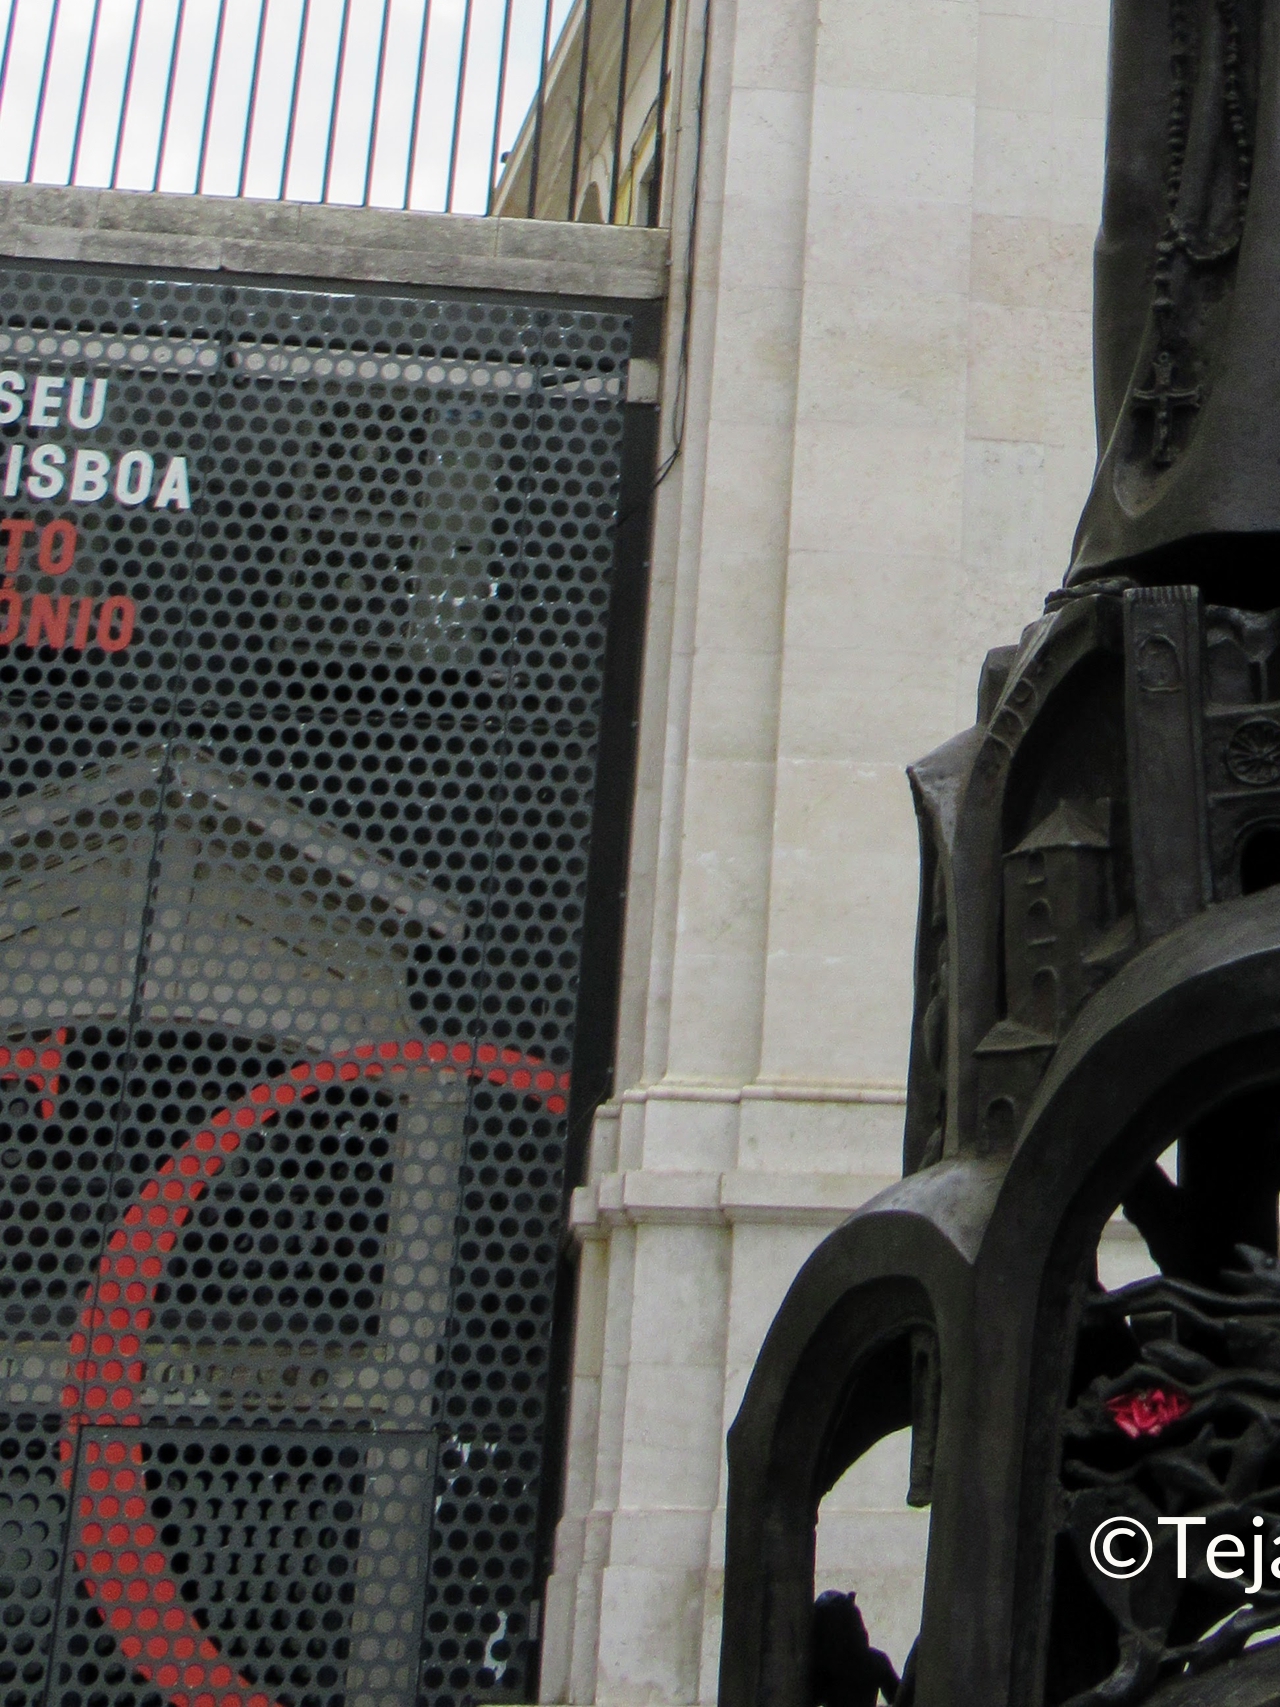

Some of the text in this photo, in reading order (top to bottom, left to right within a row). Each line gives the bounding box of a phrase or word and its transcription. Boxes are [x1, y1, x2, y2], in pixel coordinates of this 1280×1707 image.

[0, 370, 108, 429] SEU
[4, 444, 191, 509] ISBOA
[1, 518, 78, 575] TO
